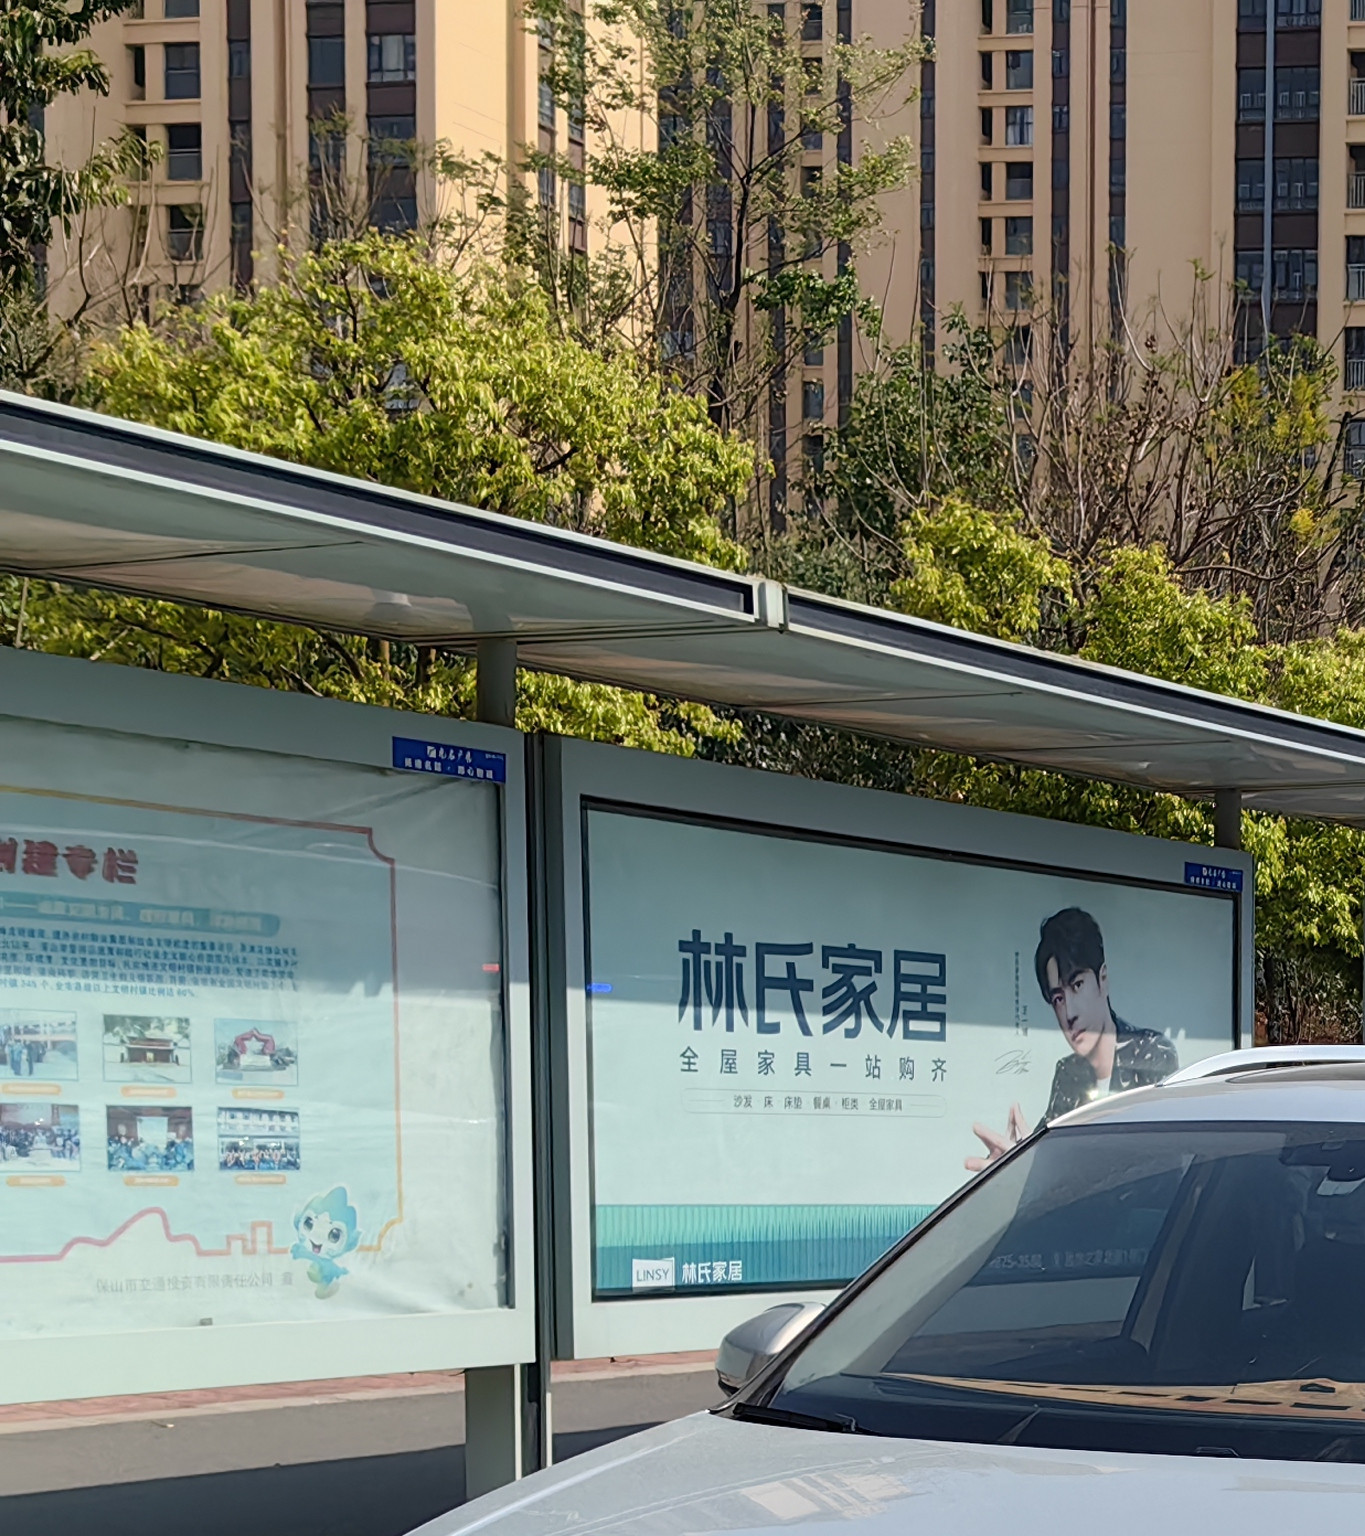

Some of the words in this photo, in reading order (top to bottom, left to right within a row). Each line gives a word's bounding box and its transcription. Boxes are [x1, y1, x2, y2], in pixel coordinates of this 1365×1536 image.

[678, 928, 947, 1043] 林氏家居
[680, 1045, 947, 1082] 全屋家具一站购齐
[636, 1268, 670, 1282] LINSY
[681, 1260, 743, 1283] 林氏家居
